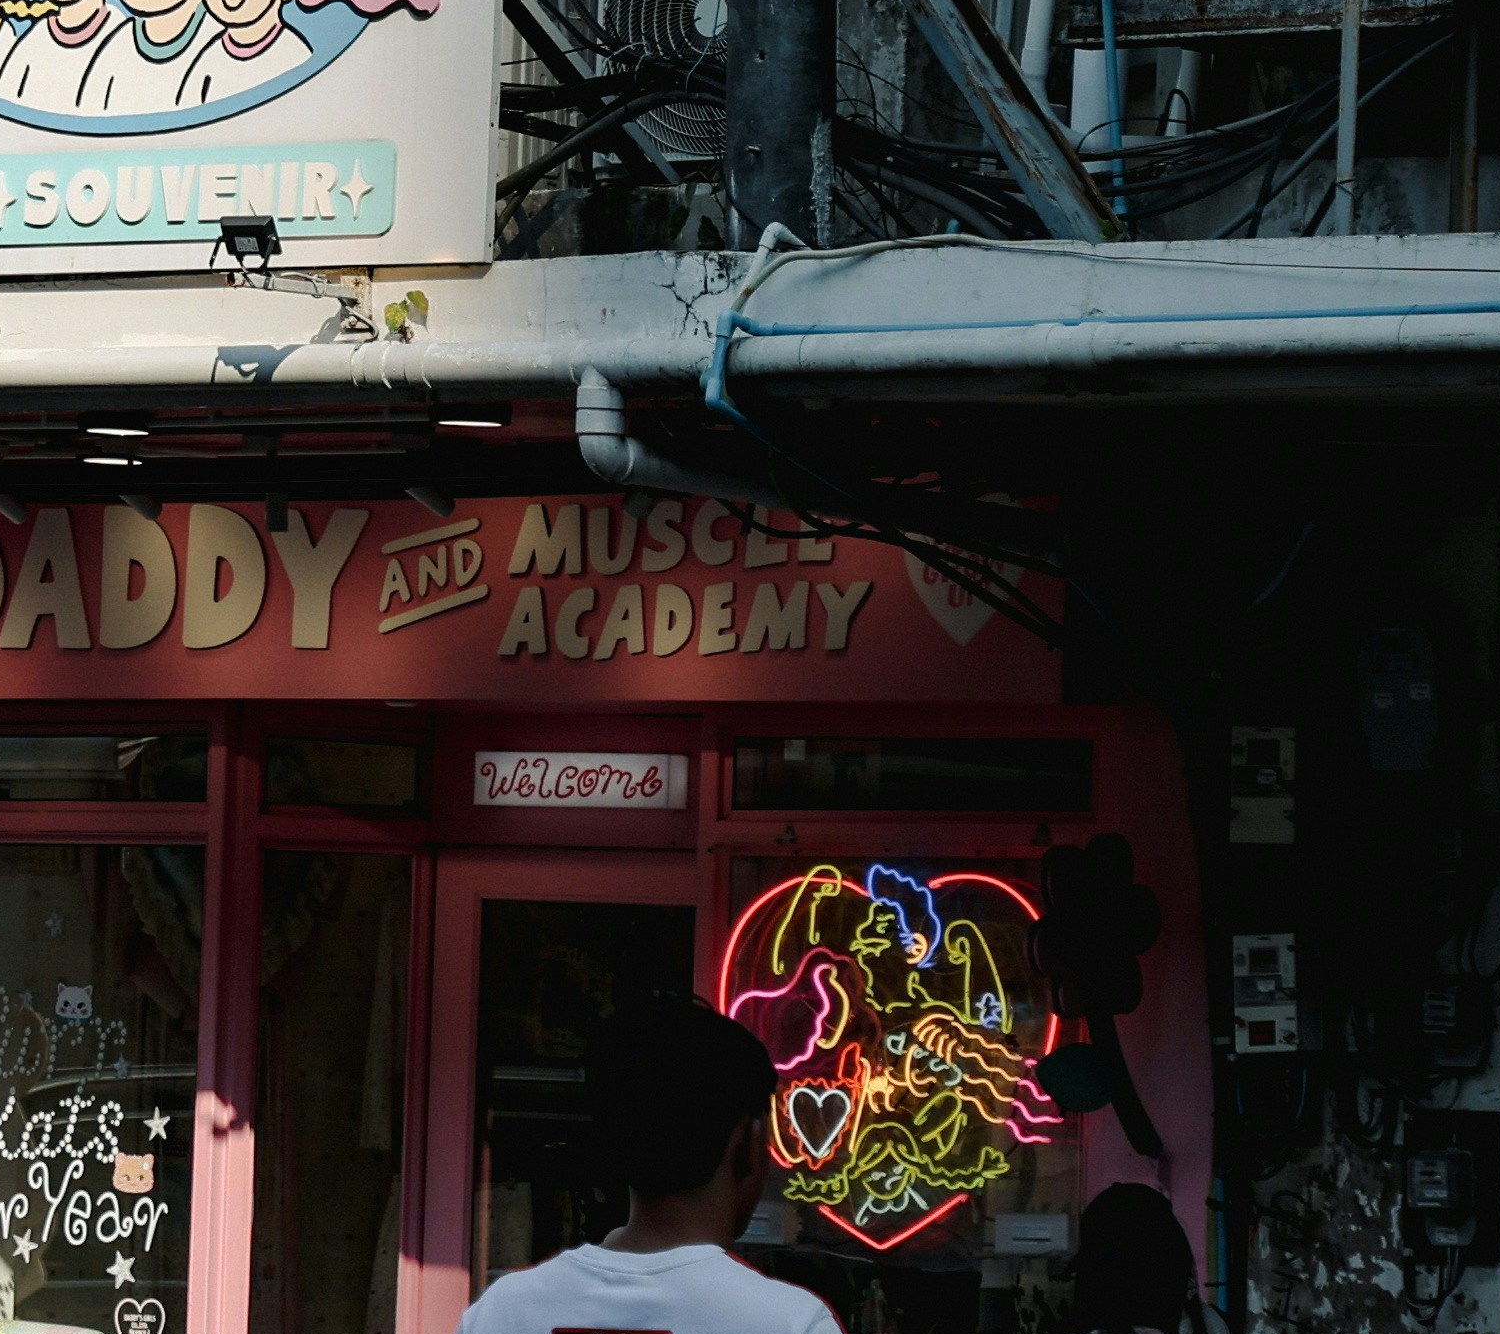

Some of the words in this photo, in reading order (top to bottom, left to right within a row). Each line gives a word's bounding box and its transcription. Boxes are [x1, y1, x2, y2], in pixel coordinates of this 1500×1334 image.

[22, 160, 338, 228] SOUVENIR
[379, 538, 485, 613] AND
[498, 580, 873, 660] ACADEMY
[26, 1159, 169, 1253] Year
